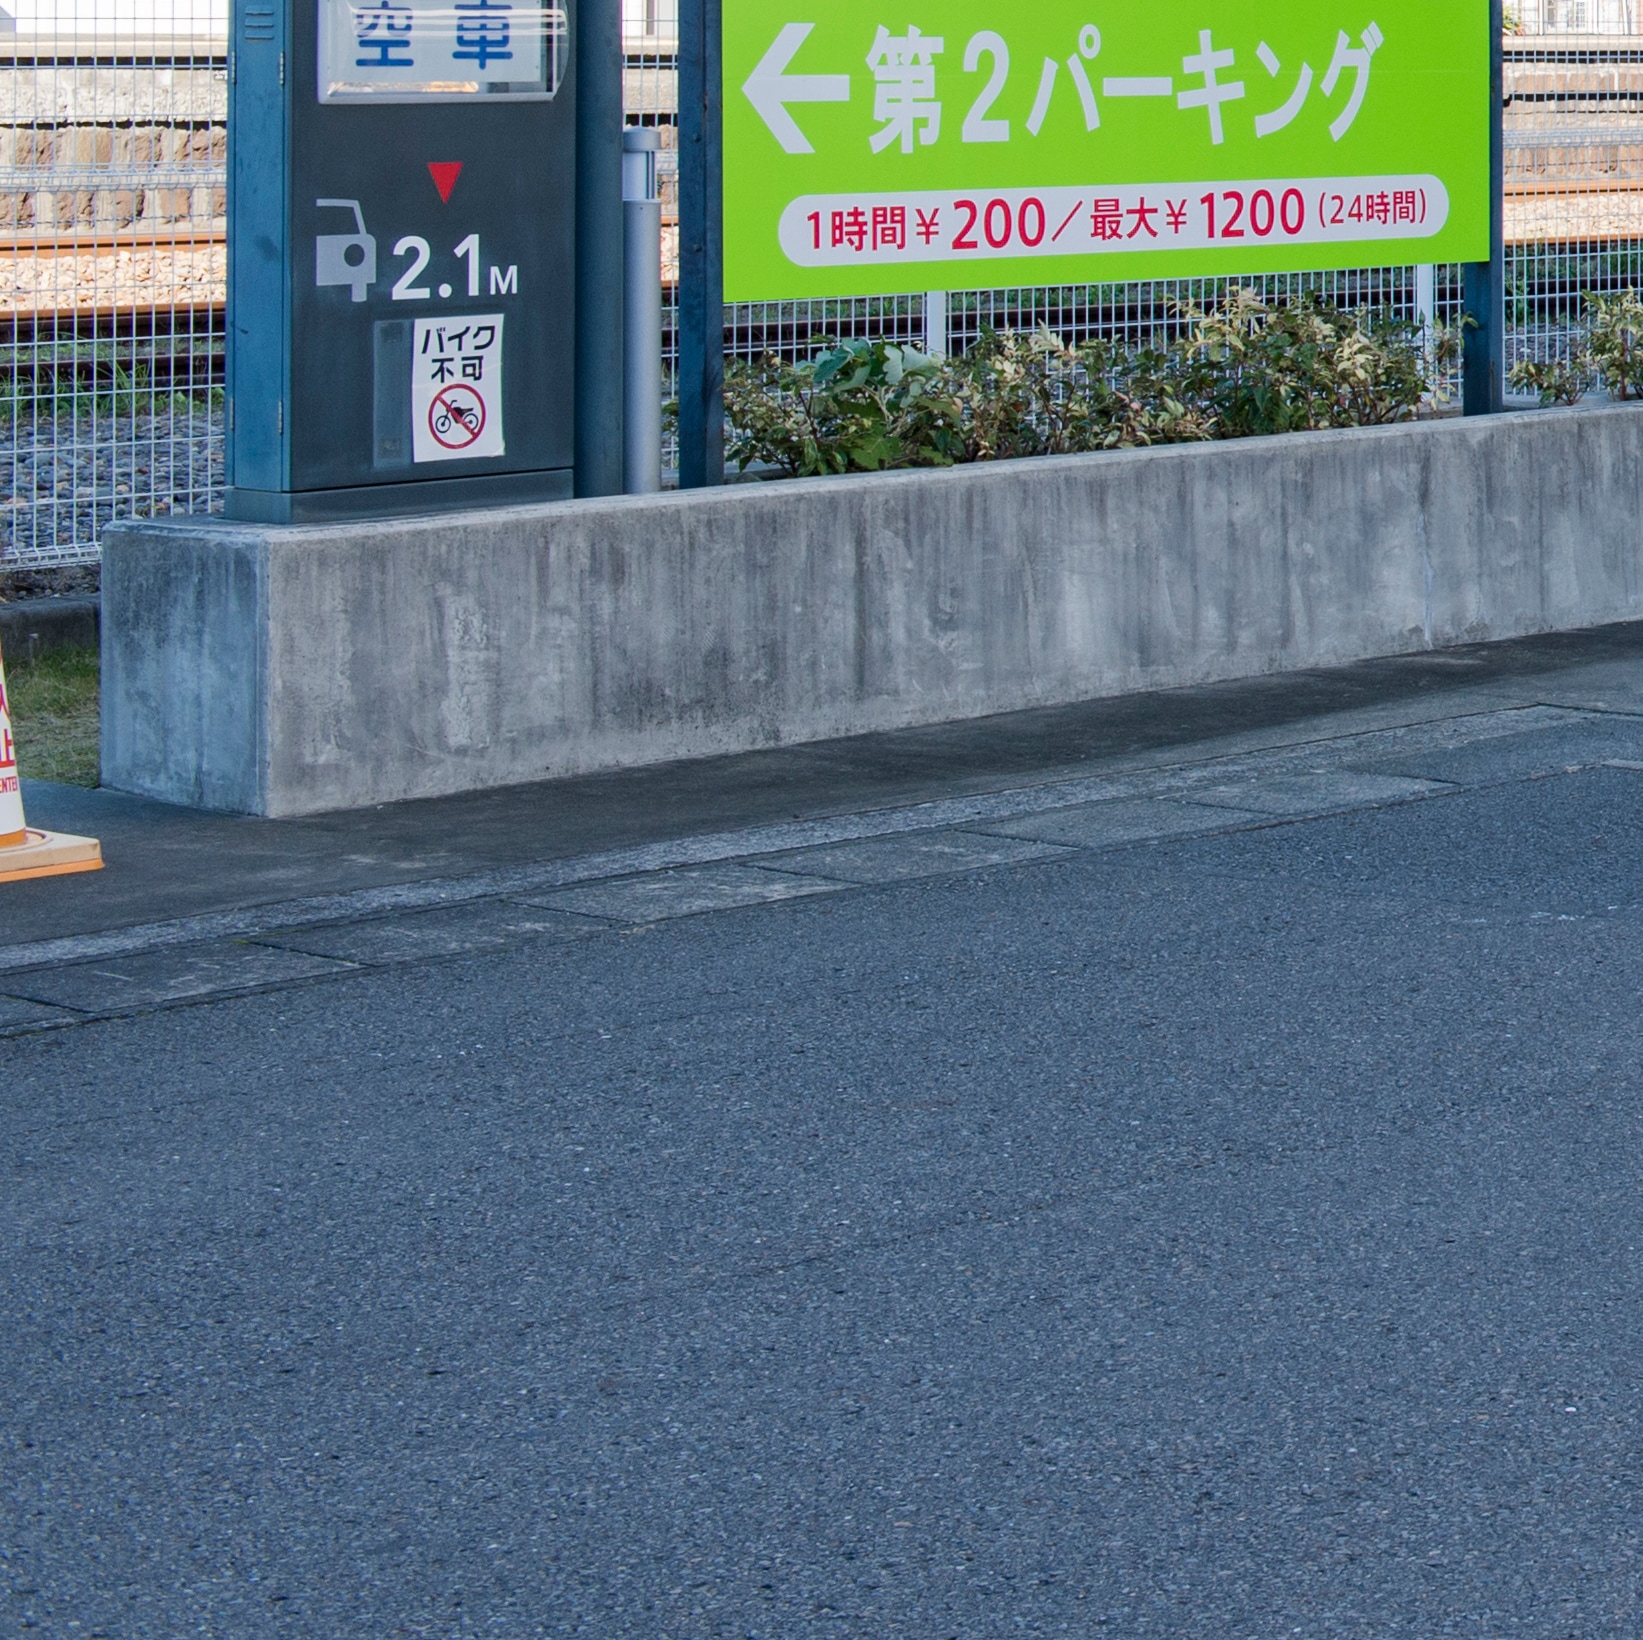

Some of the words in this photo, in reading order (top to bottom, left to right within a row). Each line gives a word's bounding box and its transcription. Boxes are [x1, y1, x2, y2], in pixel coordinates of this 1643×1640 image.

[864, 20, 1385, 154] 第2パーキング
[420, 323, 498, 356] バイク
[430, 357, 485, 383] 不可
